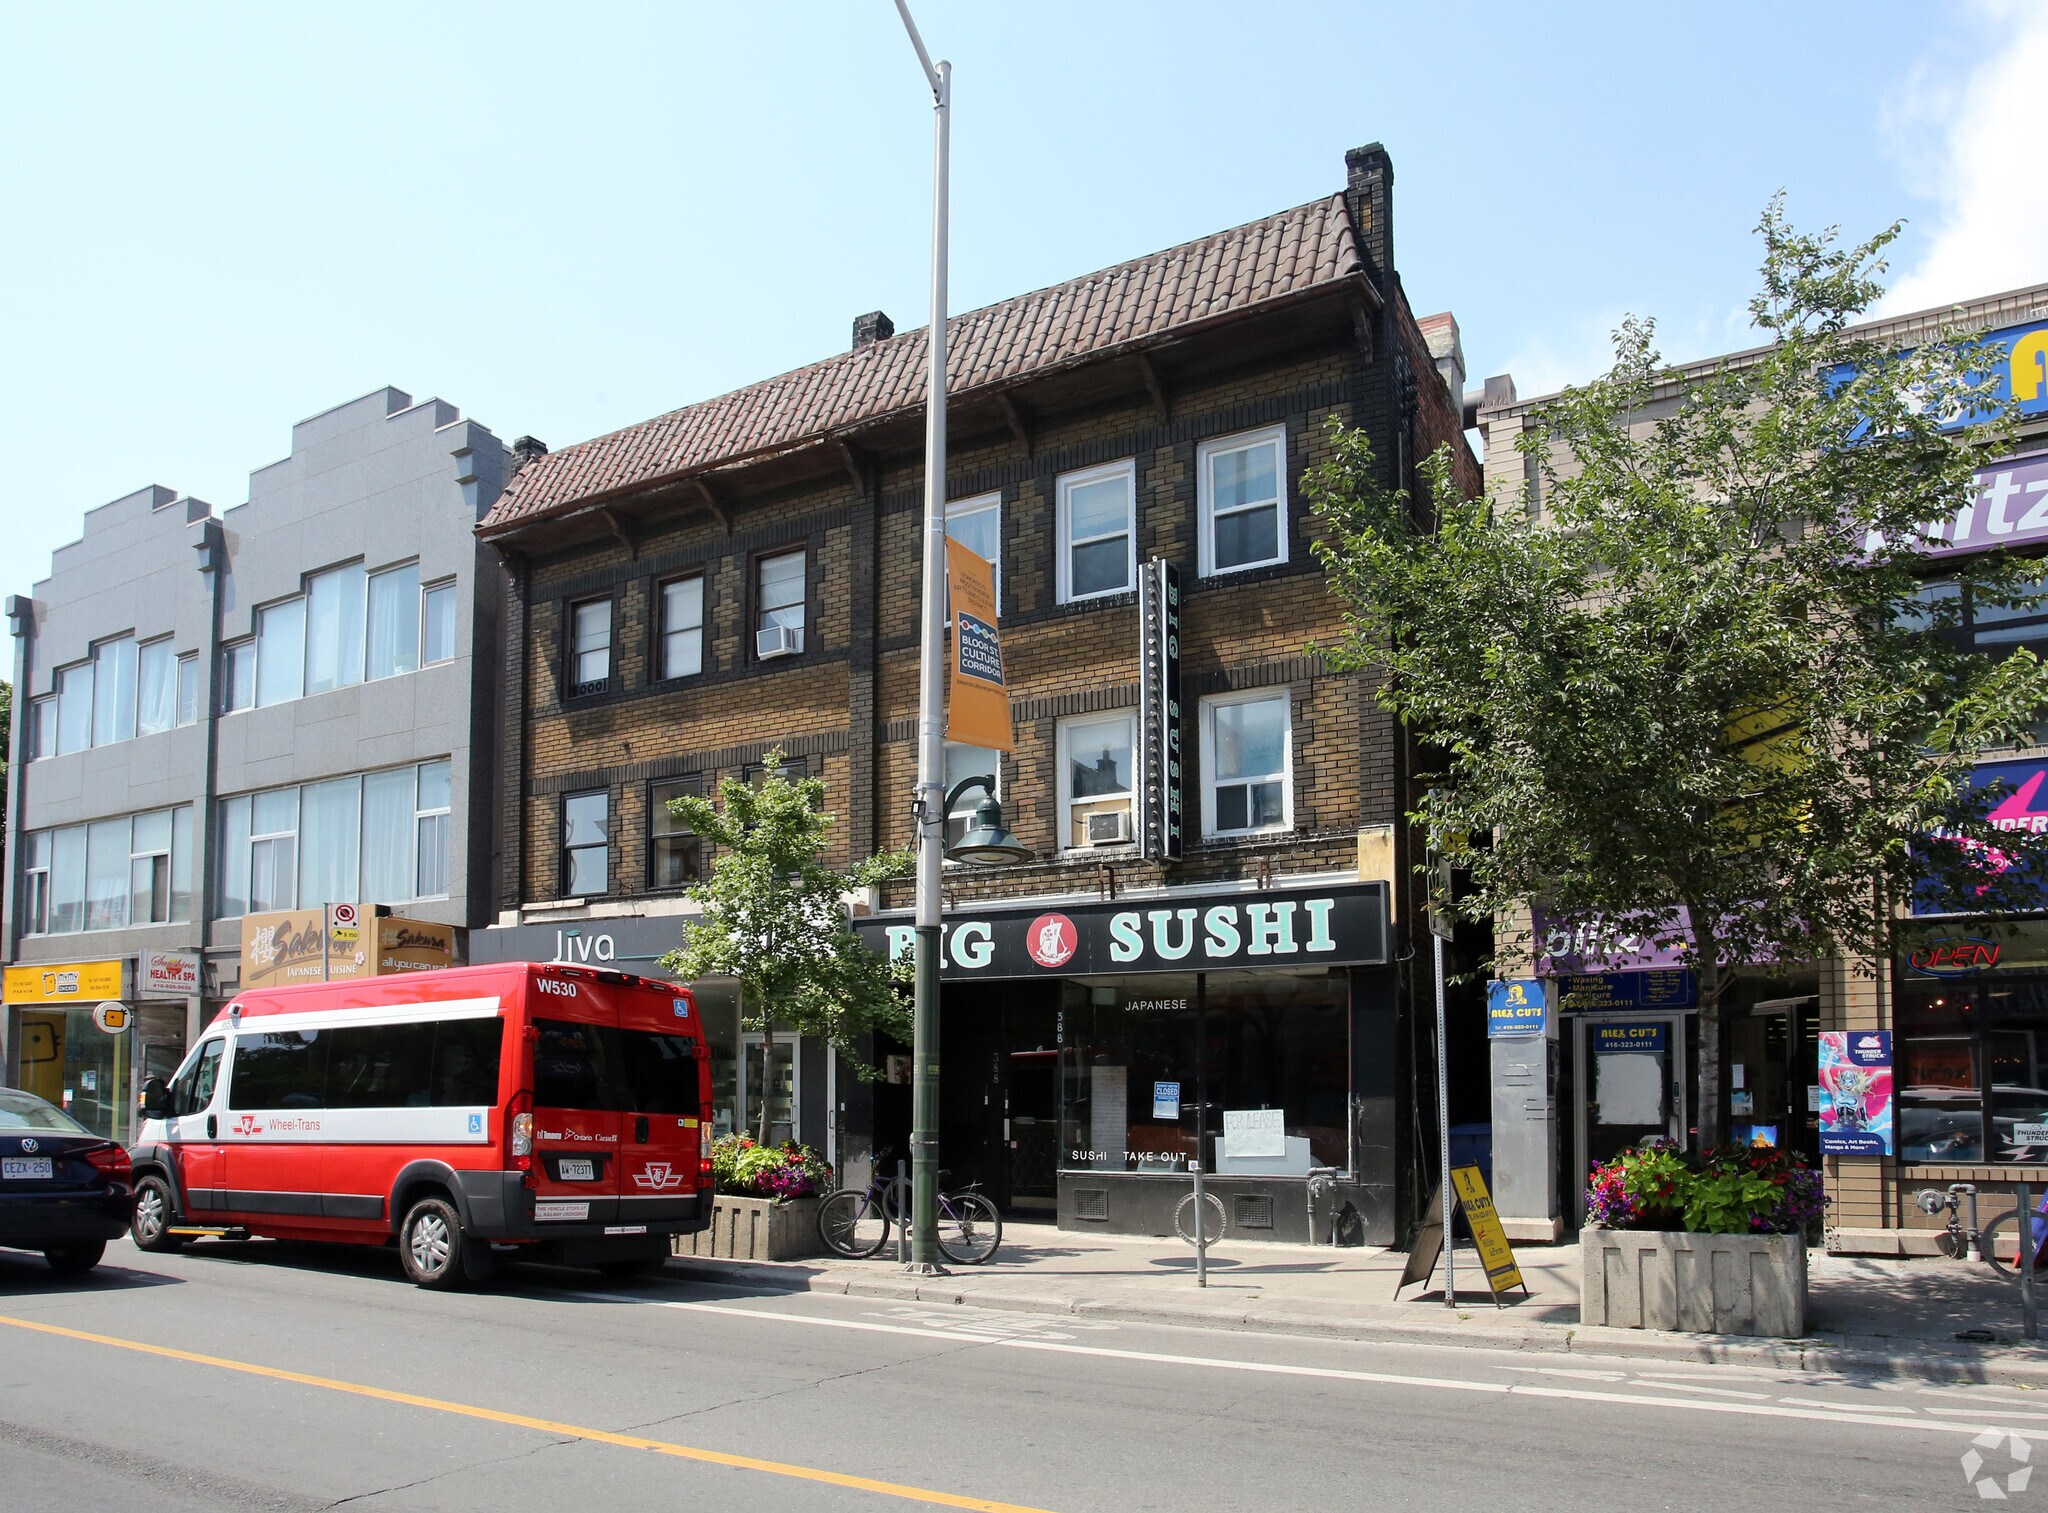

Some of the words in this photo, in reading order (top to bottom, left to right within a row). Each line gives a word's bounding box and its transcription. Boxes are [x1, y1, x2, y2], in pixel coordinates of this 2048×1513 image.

[1864, 472, 2048, 549] itz
[1168, 583, 1179, 660] BIG
[962, 635, 989, 653] BLOOR
[962, 647, 1000, 669] CULTURE
[962, 658, 1001, 679] CORRIDOR
[1169, 699, 1180, 839] SUSHI
[397, 928, 447, 947] Sakura
[1109, 898, 1336, 963] SUSHI
[382, 957, 394, 967] all
[394, 960, 412, 972] you
[413, 962, 431, 970] can
[1911, 945, 2000, 969] OPEN
[150, 969, 177, 980] HEALTH
[183, 972, 196, 982] SPA
[287, 966, 322, 977] JAPANESE
[328, 965, 357, 974] UISINE
[536, 977, 577, 997] W530
[1572, 976, 1603, 985] Waxing
[1125, 999, 1187, 1011] JAPANESE
[1491, 1009, 1514, 1018] ALEX
[1516, 1008, 1542, 1017] CUTS
[1601, 1029, 1626, 1039] ALEX
[1629, 1028, 1658, 1038] CUTS
[1156, 1087, 1178, 1096] CLOSED
[269, 1118, 321, 1131] Wheel-Trans
[1226, 1113, 1244, 1130] FOR
[1247, 1111, 1281, 1130] LEASE
[1072, 1150, 1107, 1161] SUSHI
[1123, 1151, 1154, 1162] TAKE
[1160, 1151, 1187, 1162] OUT
